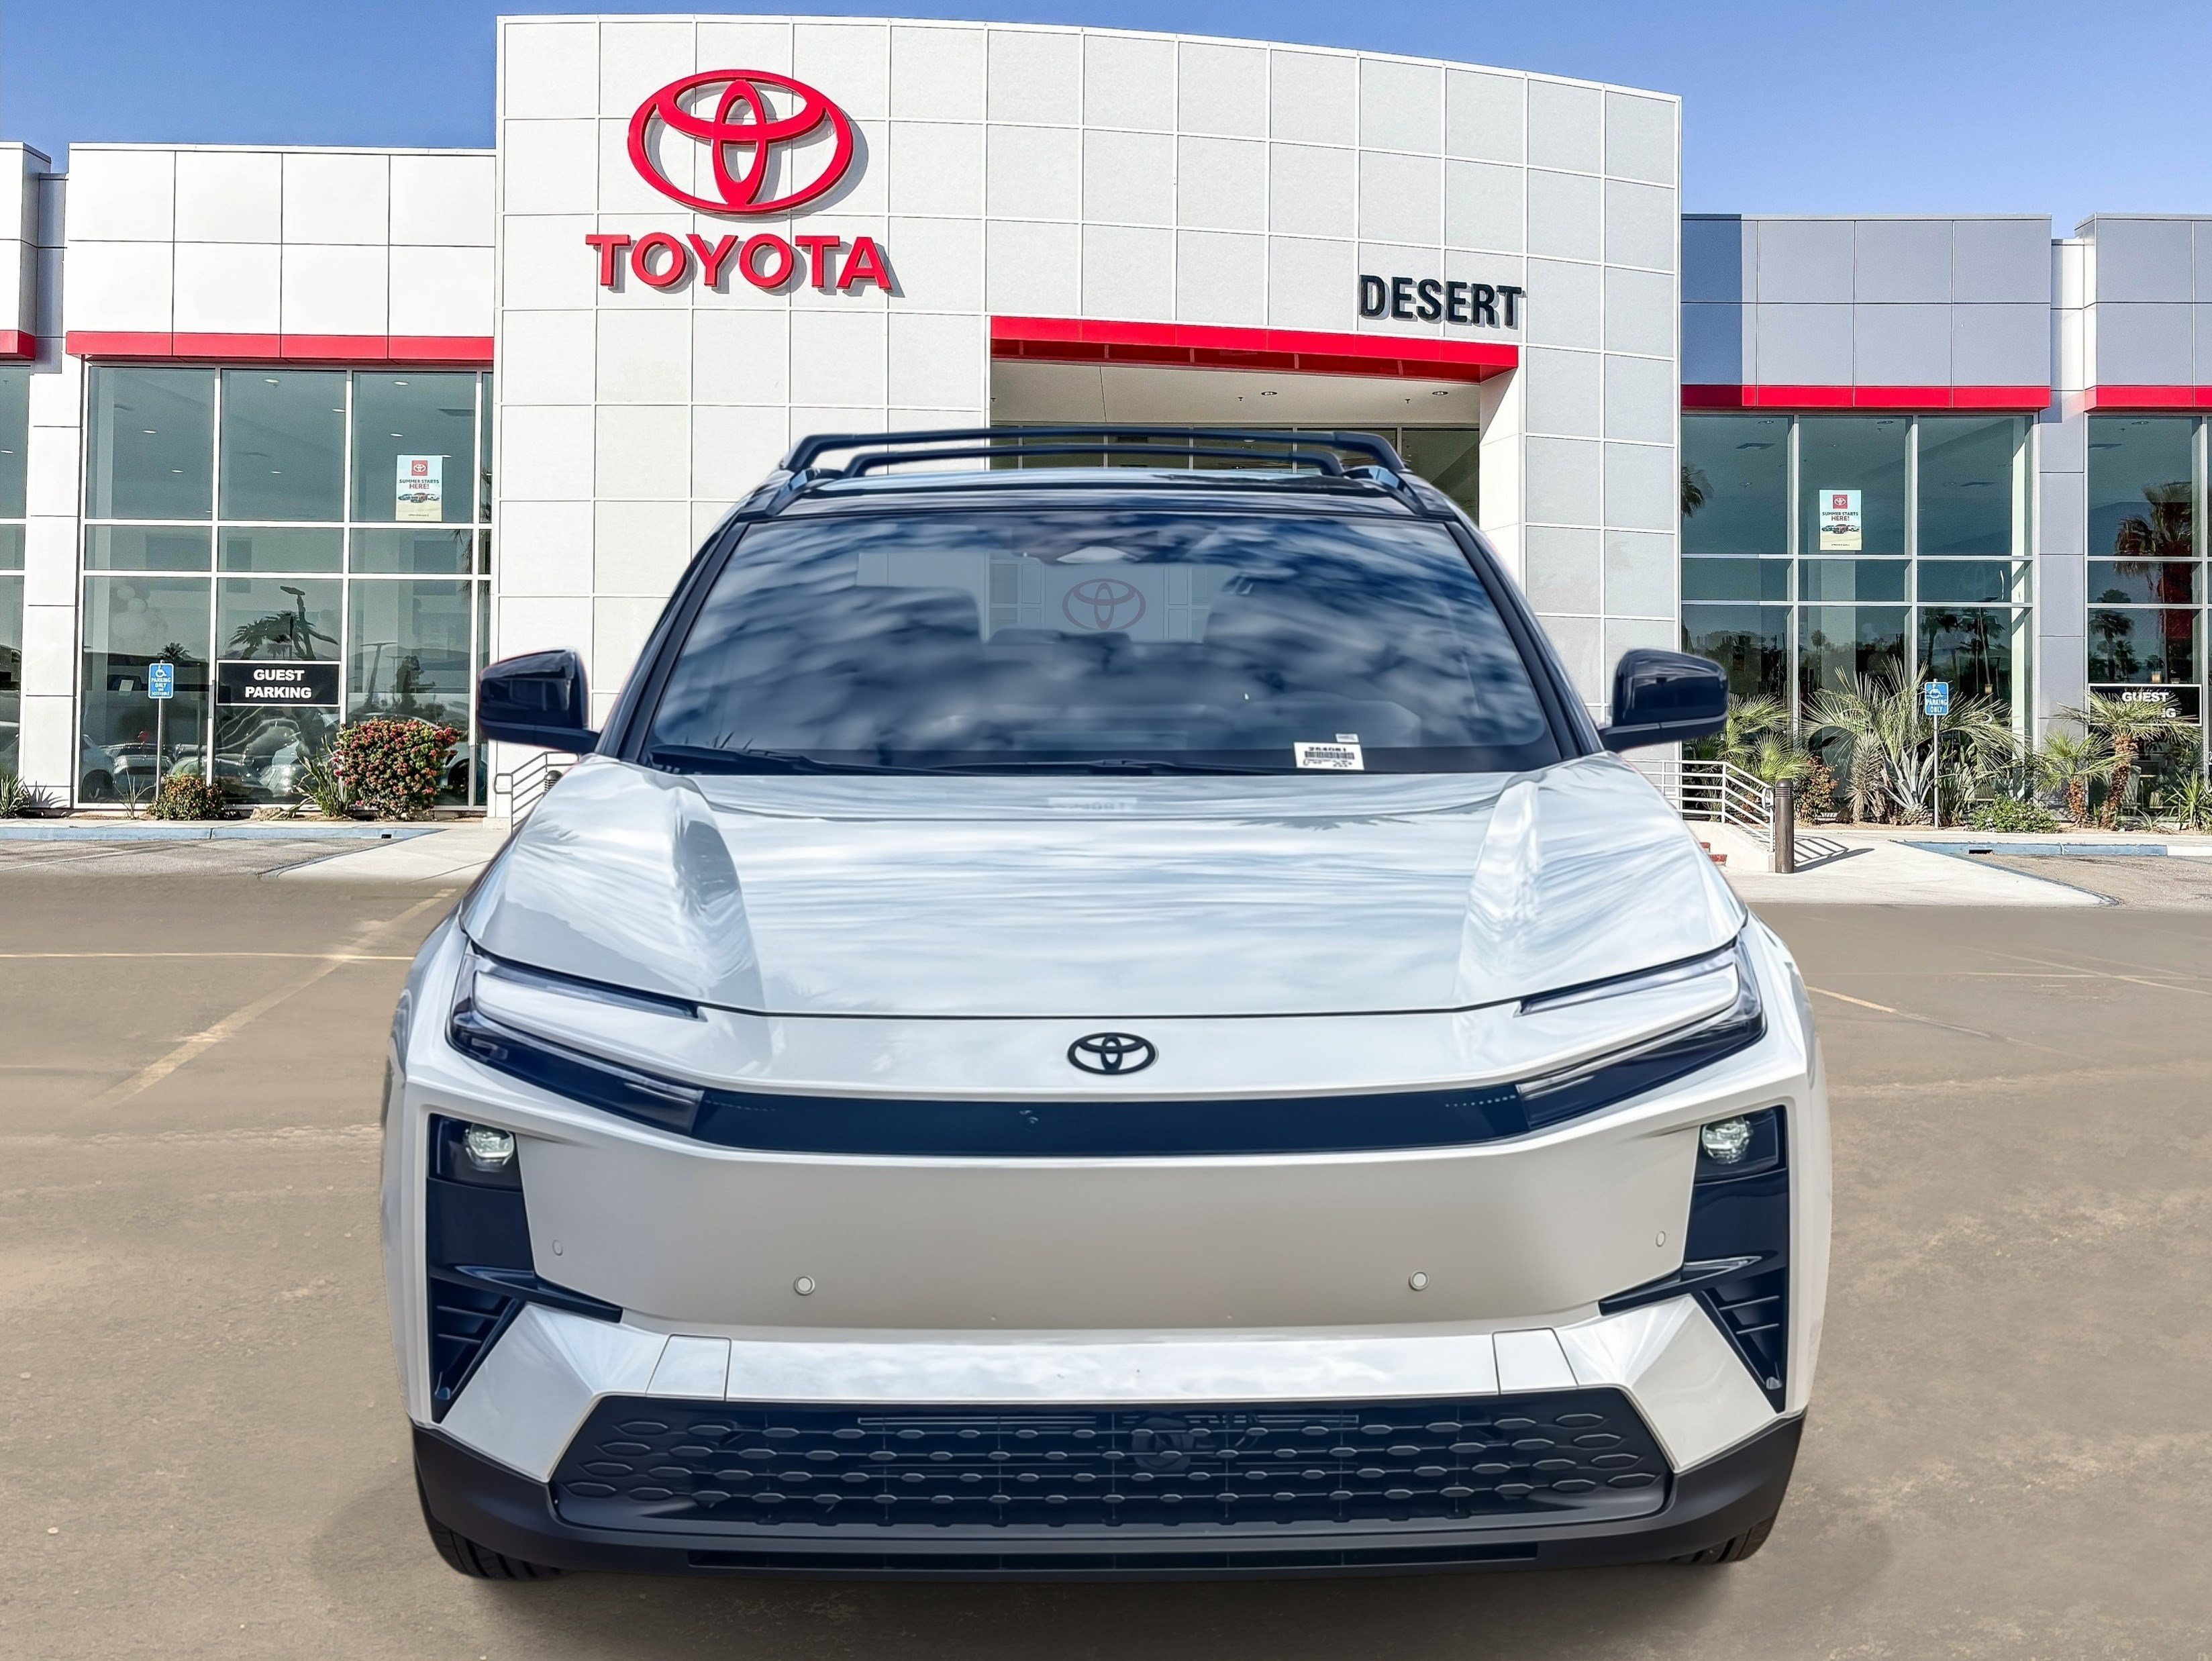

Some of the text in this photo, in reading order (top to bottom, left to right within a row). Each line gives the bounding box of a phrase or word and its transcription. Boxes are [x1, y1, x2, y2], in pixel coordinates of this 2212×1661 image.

[585, 232, 893, 290] TOYOTA
[1359, 274, 1522, 326] DESERT
[254, 669, 305, 681] GUEST
[245, 687, 311, 699] PARKING
[2121, 692, 2169, 702] GUEST
